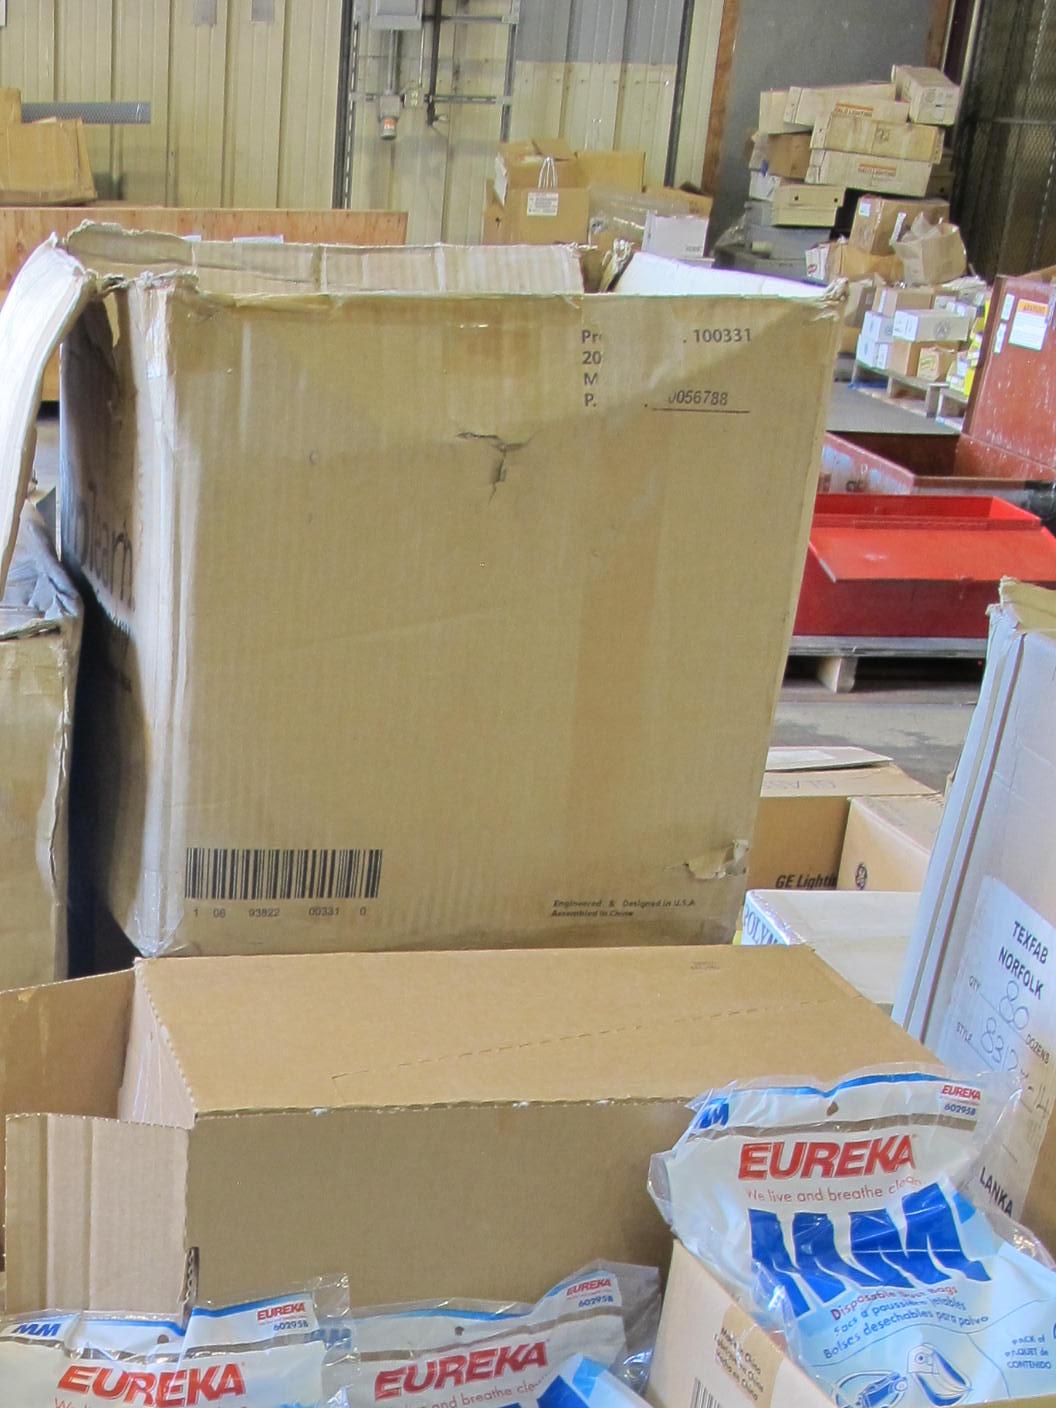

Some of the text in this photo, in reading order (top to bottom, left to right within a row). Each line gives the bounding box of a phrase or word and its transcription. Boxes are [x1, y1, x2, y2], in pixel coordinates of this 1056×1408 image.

[692, 328, 752, 344] 100331
[775, 875, 795, 889] GE
[1014, 921, 1049, 964] TEXFAB
[997, 946, 1044, 1000] NORFOLK
[941, 1084, 981, 1101] EUREKA
[737, 1134, 918, 1182] EUREKA
[768, 1184, 884, 1203] live and breathe
[979, 1166, 1014, 1218] LANKA
[747, 1181, 993, 1319] MM
[565, 1278, 612, 1297] EUREKA
[256, 1302, 306, 1321] EUREKA
[10, 1322, 60, 1337] MM
[374, 1340, 549, 1402] EUREKA
[57, 1363, 246, 1408] EUREKA
[461, 1383, 513, 1407] breathe
